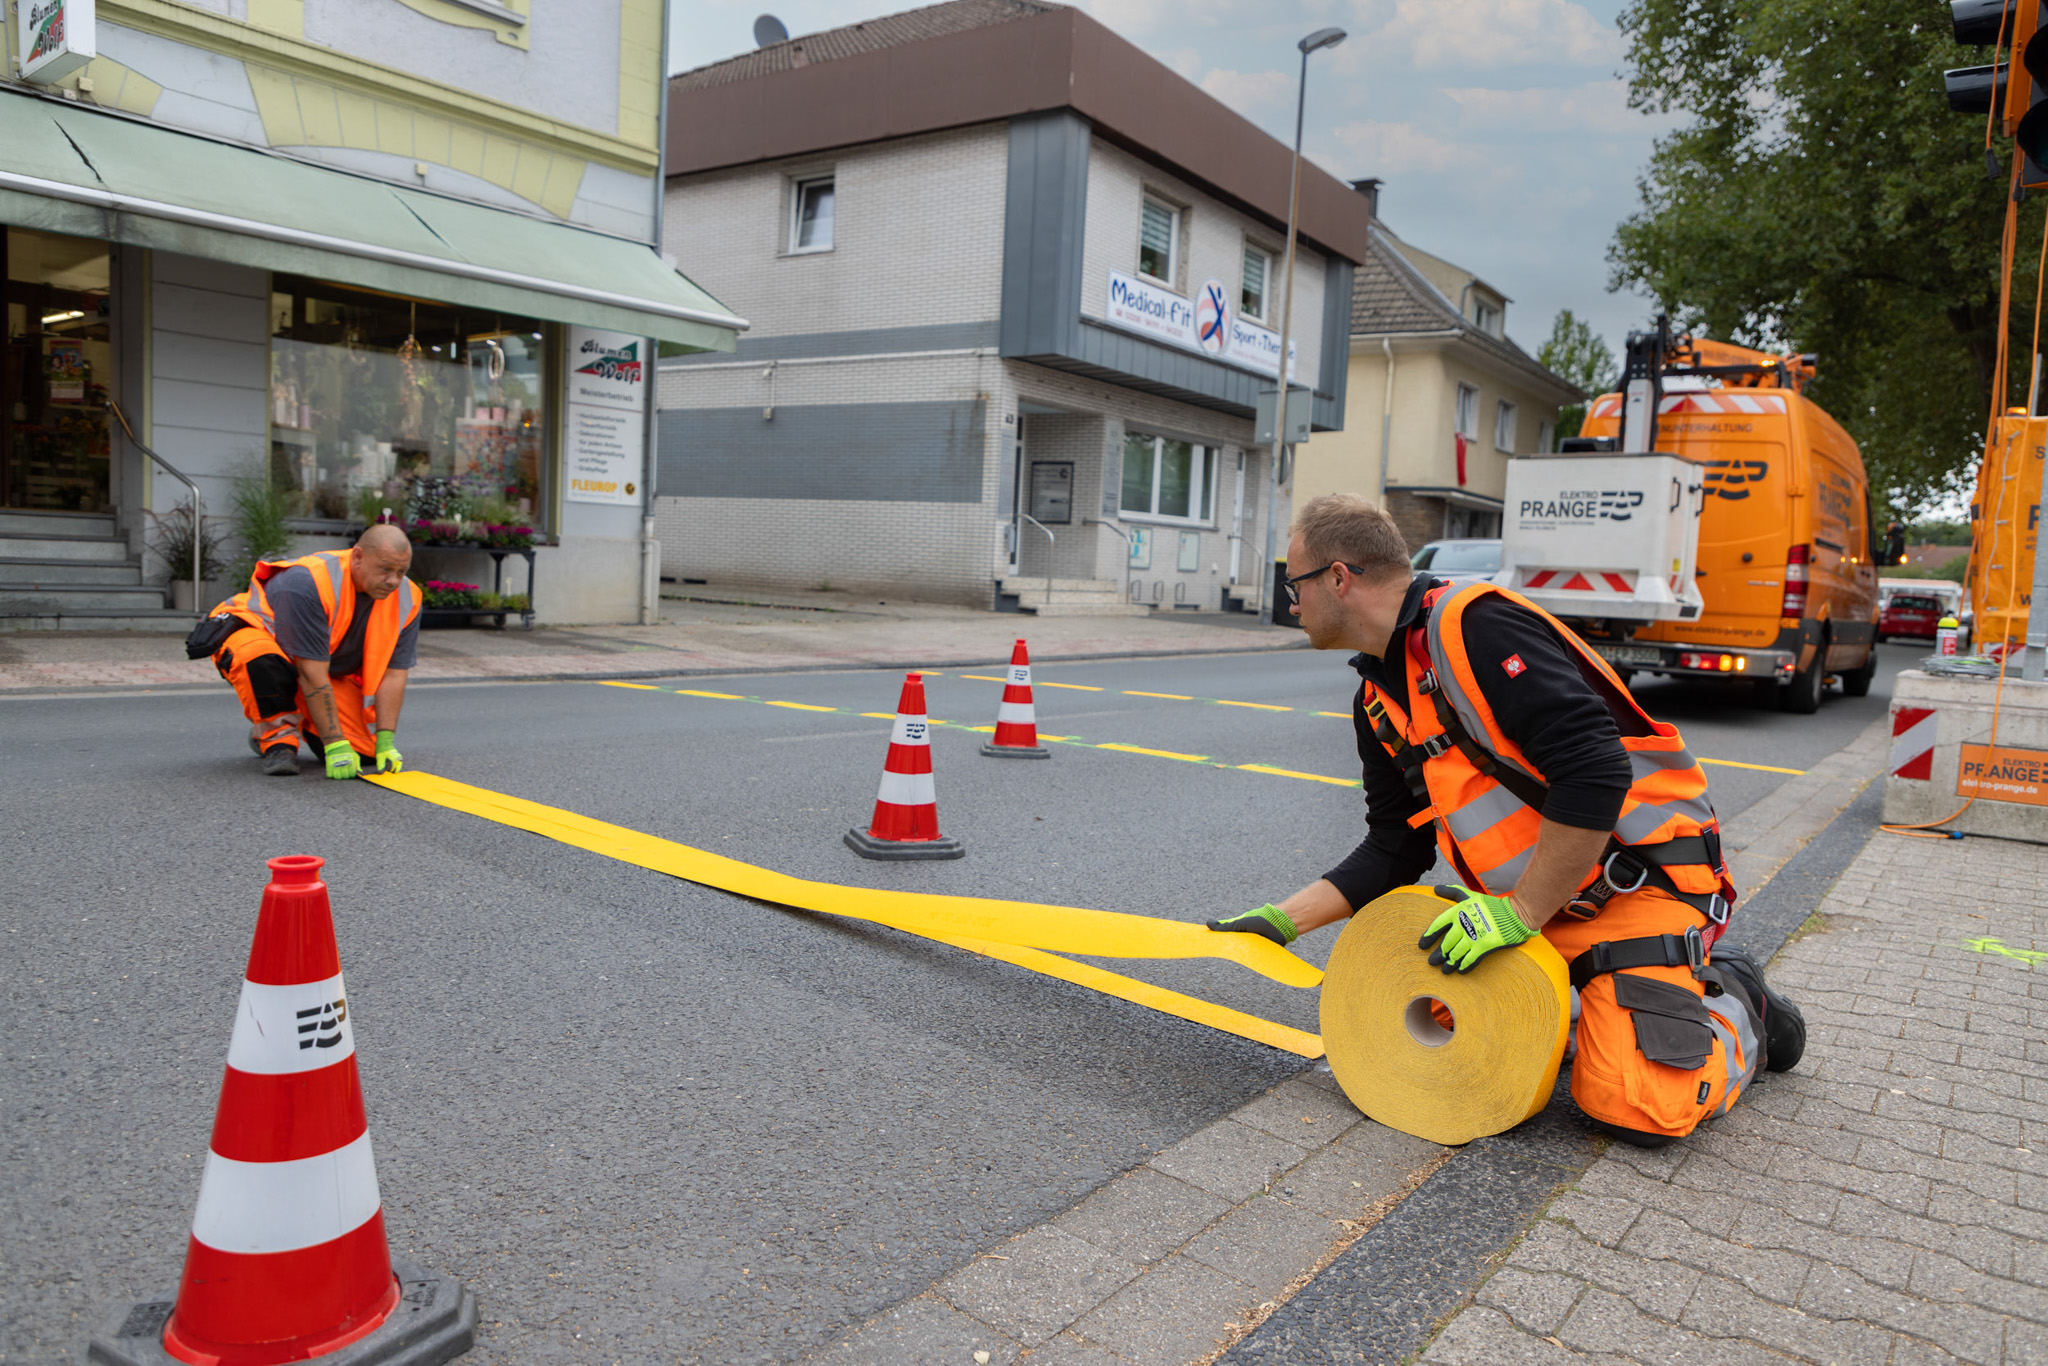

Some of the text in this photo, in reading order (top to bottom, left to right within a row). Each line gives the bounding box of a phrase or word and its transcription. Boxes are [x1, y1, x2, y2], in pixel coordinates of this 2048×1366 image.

[581, 339, 632, 359] Blumen
[595, 361, 640, 385] Wolf
[572, 478, 617, 493] FLEUROP
[1559, 490, 1599, 499] ELEKTRO
[1520, 501, 1597, 518] PRANGE
[1964, 761, 2040, 783] PRANGE
[2003, 758, 2041, 768] ELEKTRO
[1459, 912, 1478, 940] STRONG
